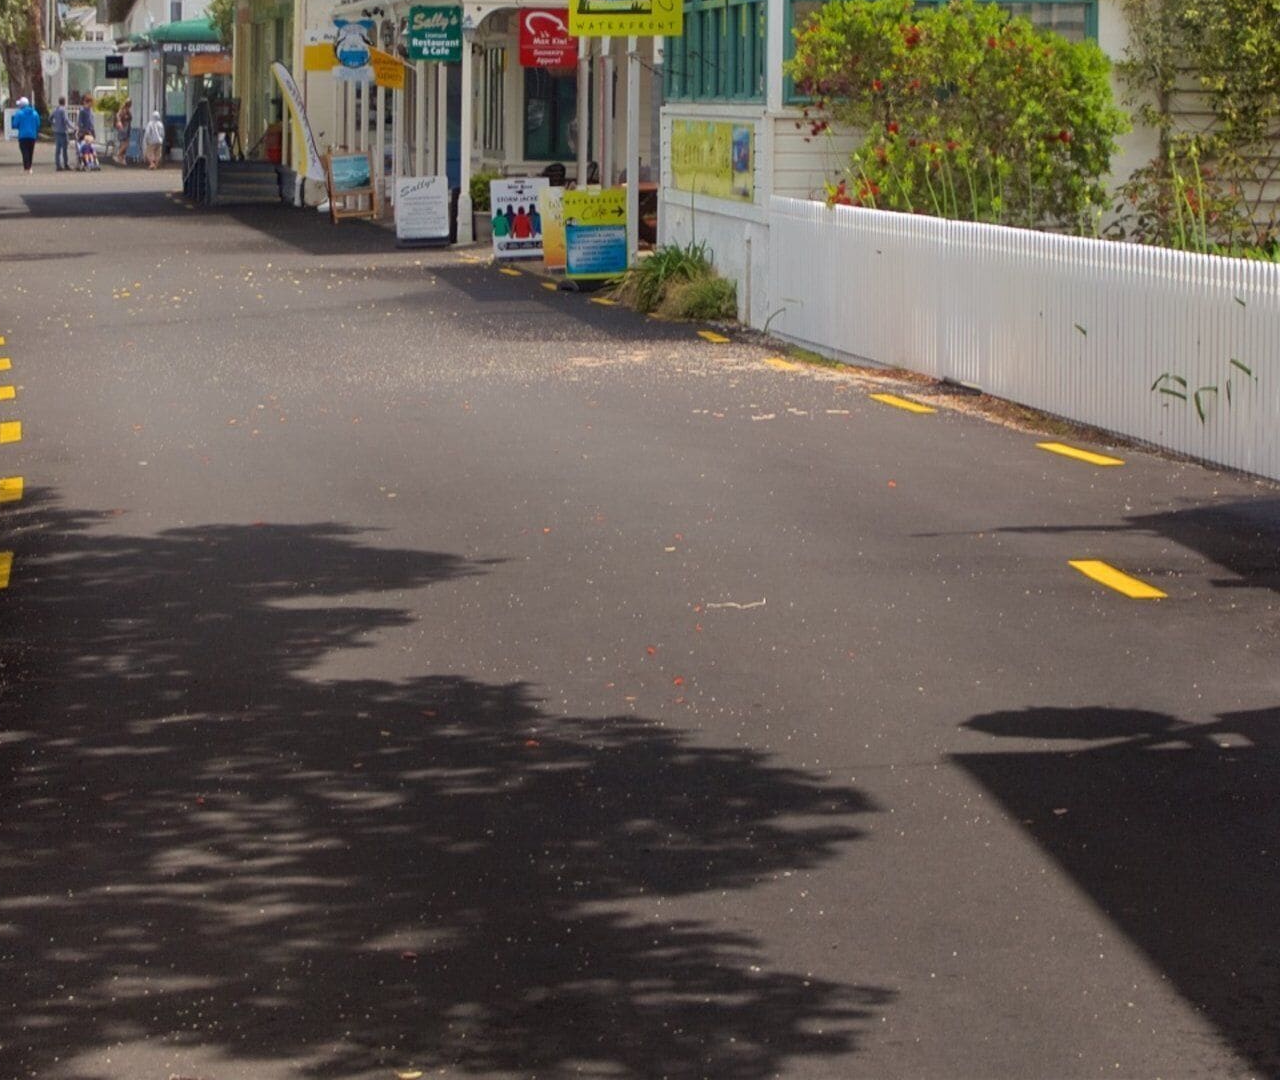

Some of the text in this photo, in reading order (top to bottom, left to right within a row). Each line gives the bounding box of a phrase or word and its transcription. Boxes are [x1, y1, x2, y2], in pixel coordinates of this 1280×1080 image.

[412, 10, 458, 31] Sally's
[576, 20, 675, 30] WATERFRONT
[163, 42, 221, 52] GIFTS CLOTHING
[412, 38, 460, 48] Restaurant
[422, 46, 450, 56] & Cafe
